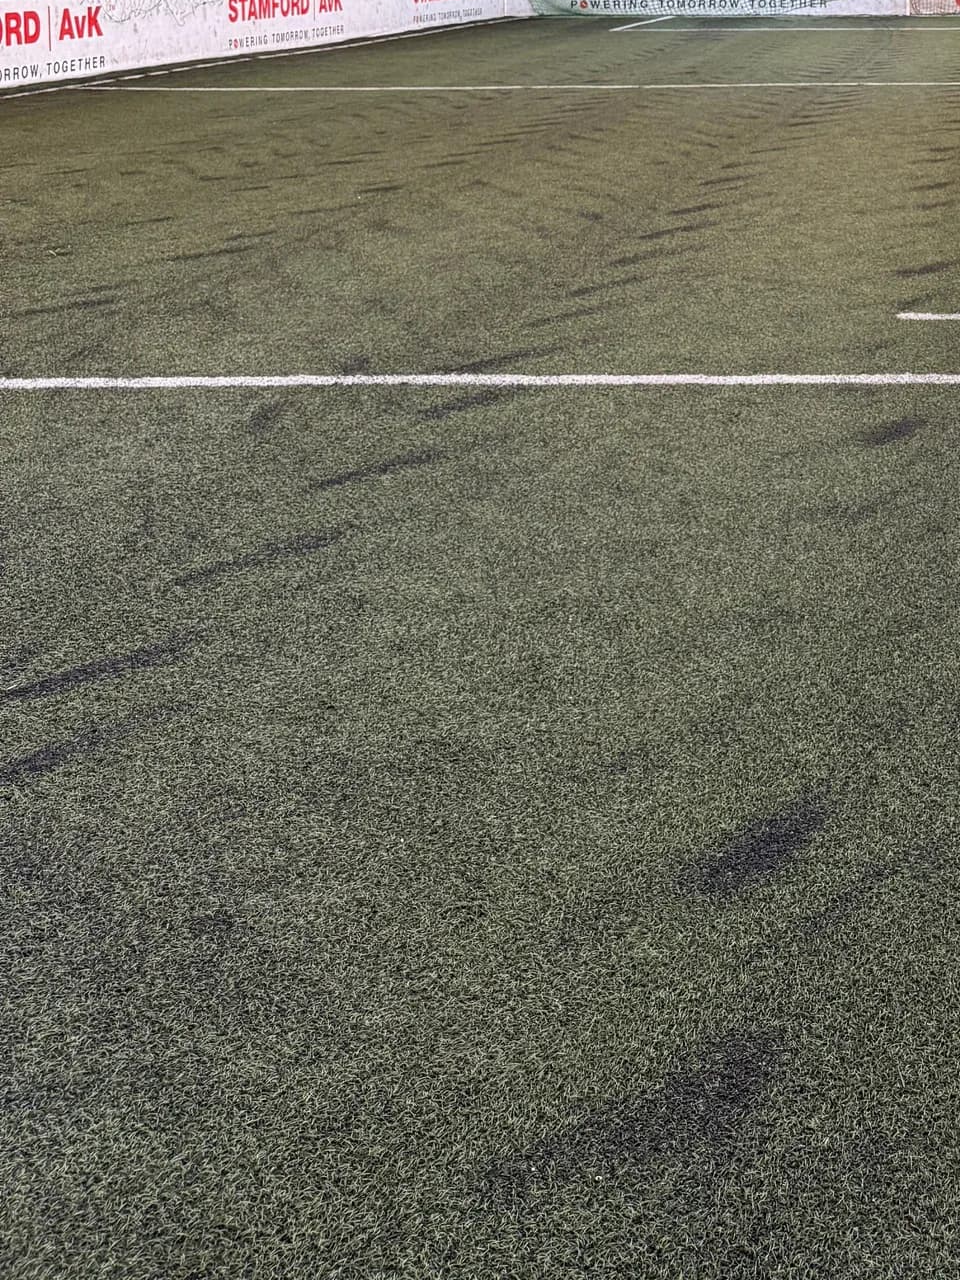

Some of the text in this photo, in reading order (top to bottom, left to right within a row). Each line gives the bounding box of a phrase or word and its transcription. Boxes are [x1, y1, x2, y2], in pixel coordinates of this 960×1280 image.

[570, 0, 649, 9] POWERING
[750, 0, 828, 9] TOGETHER
[0, 5, 103, 47] RD AvK
[228, 34, 268, 49] POWERING
[312, 24, 345, 38] TOGETHER
[47, 55, 105, 76] TOGETHER
